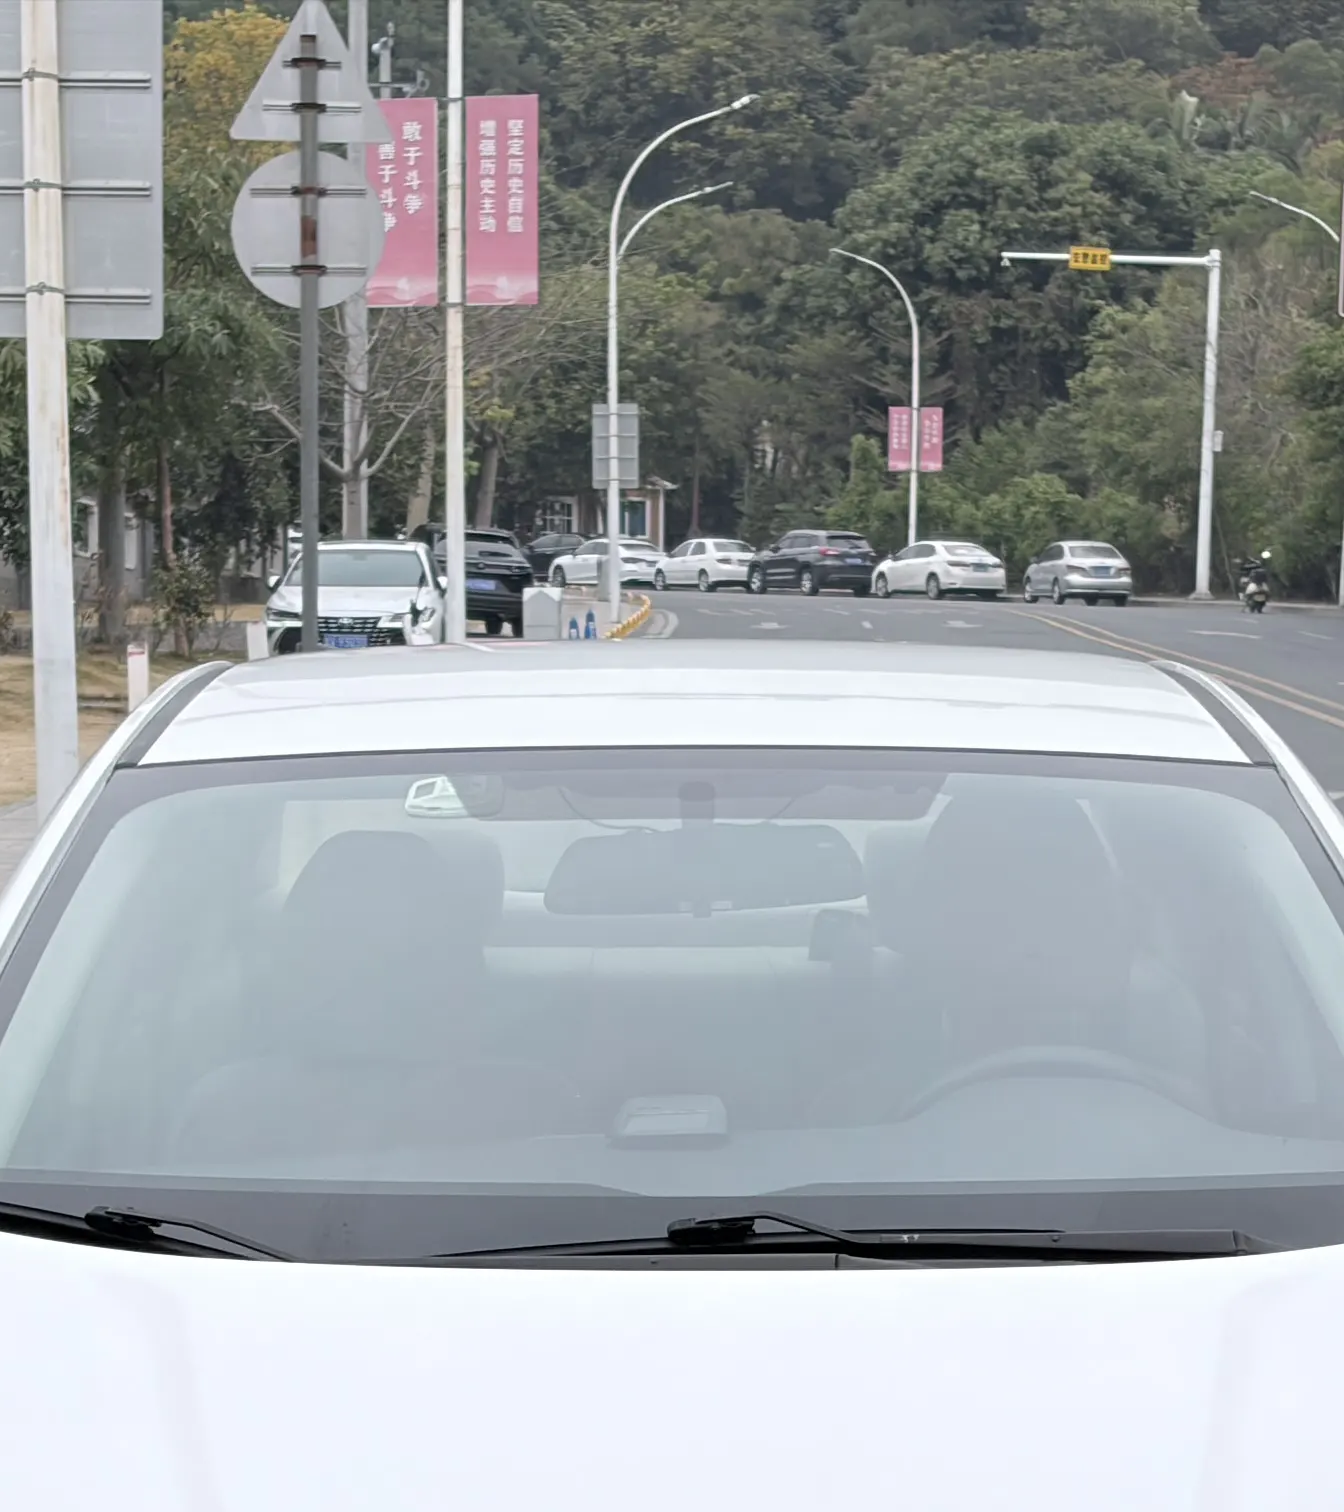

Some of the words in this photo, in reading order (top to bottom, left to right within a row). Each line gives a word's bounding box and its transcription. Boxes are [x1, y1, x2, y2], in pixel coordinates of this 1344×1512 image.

[402, 121, 424, 215] 敢于斗争
[479, 120, 497, 232] 增强历史主动
[506, 119, 525, 233] 坚定历史自信
